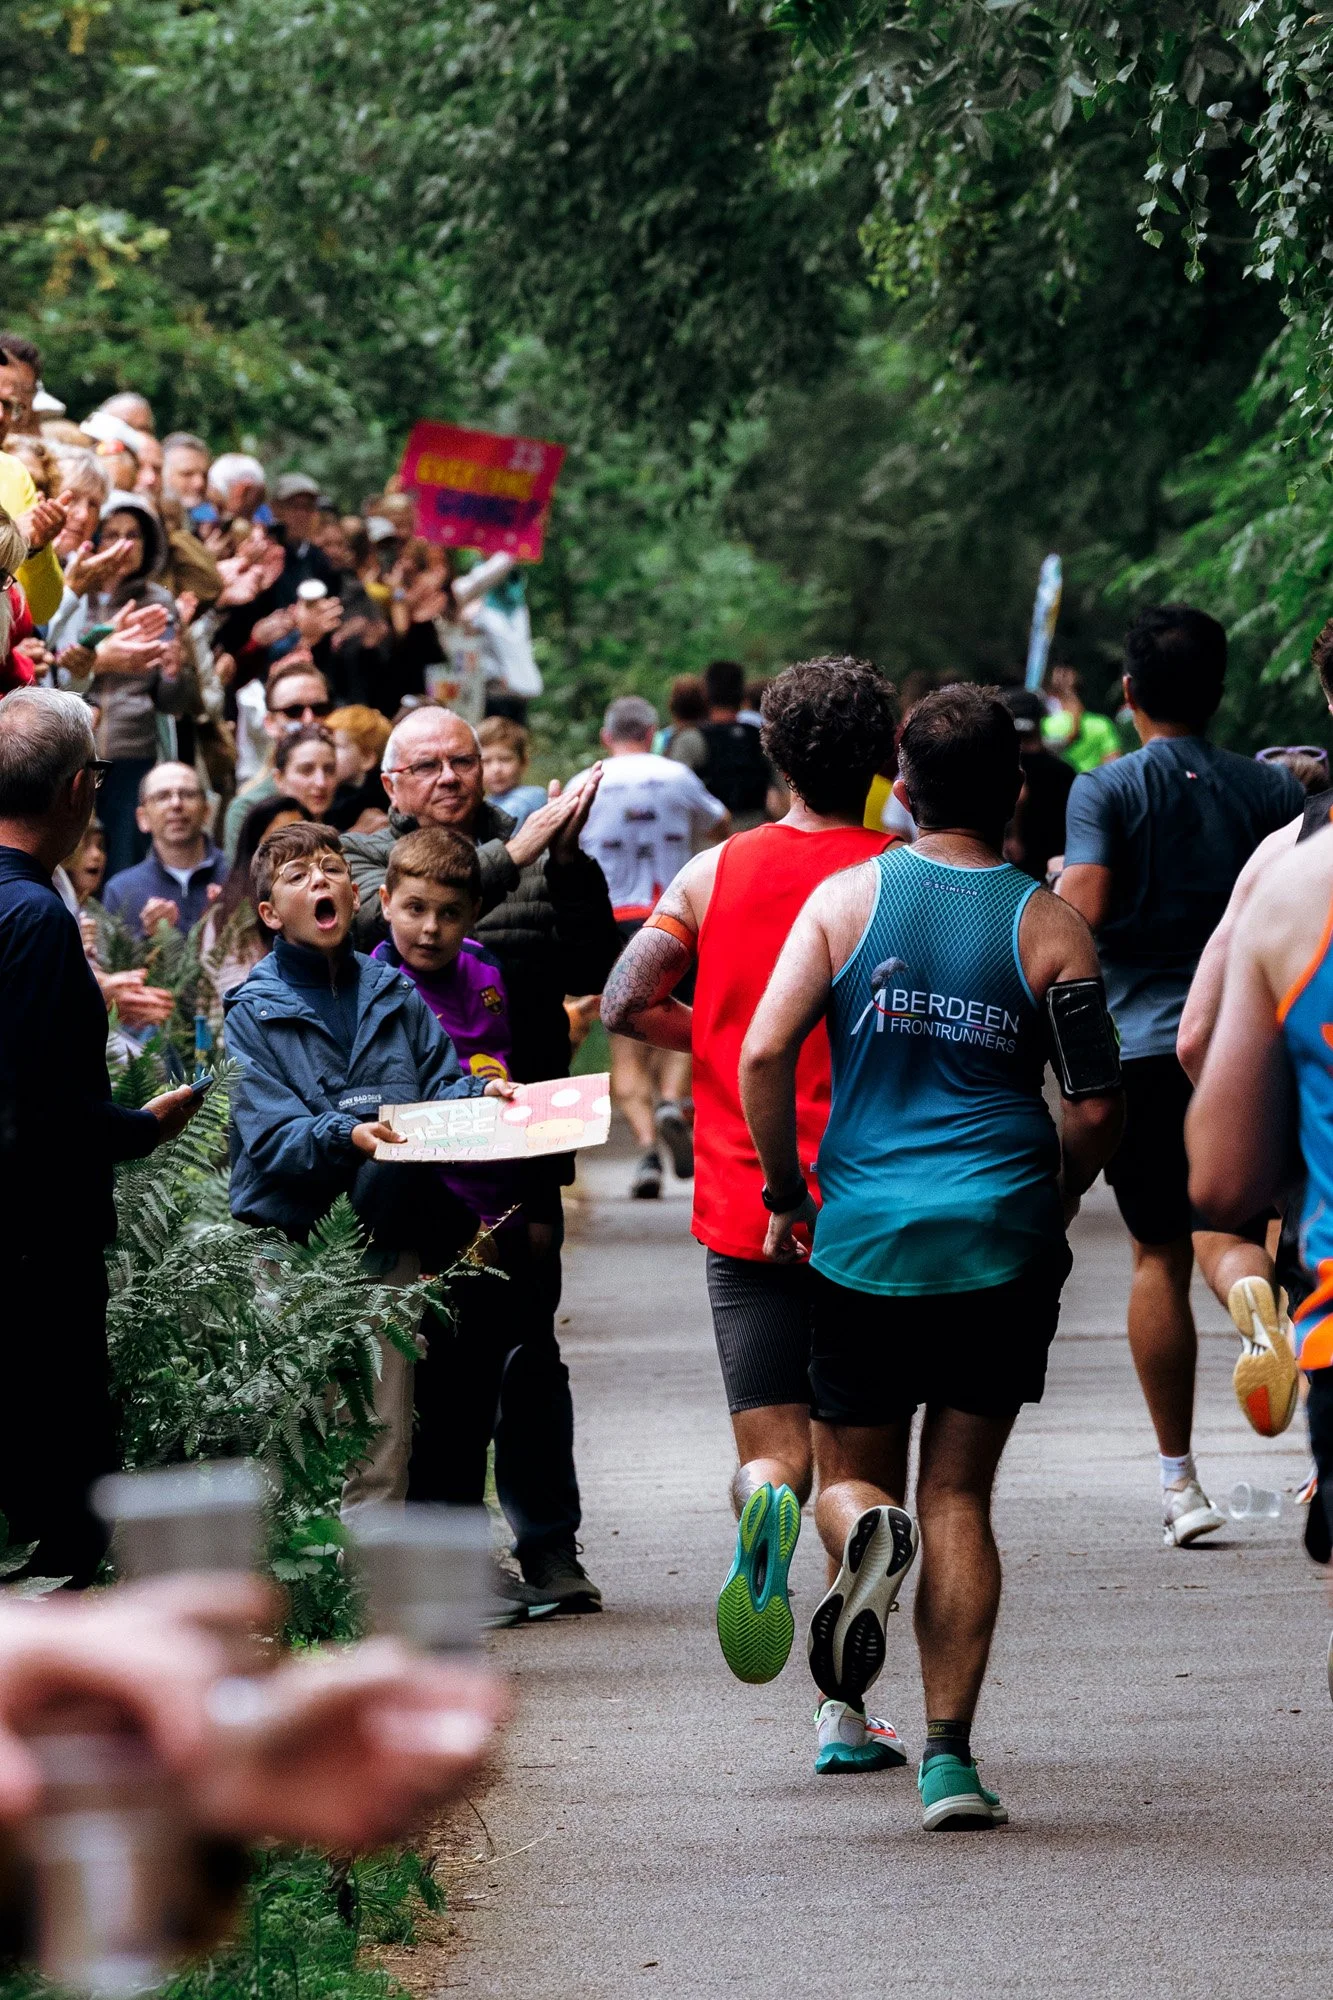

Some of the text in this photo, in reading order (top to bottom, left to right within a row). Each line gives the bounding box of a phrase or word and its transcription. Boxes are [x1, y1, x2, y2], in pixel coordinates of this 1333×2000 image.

[934, 883, 978, 896] SCIMITAR
[851, 988, 1020, 1035] ABERDEEN
[890, 1017, 1017, 1054] FRONTRUNNERS
[399, 1096, 499, 1125] TAP
[397, 1116, 495, 1142] HERE
